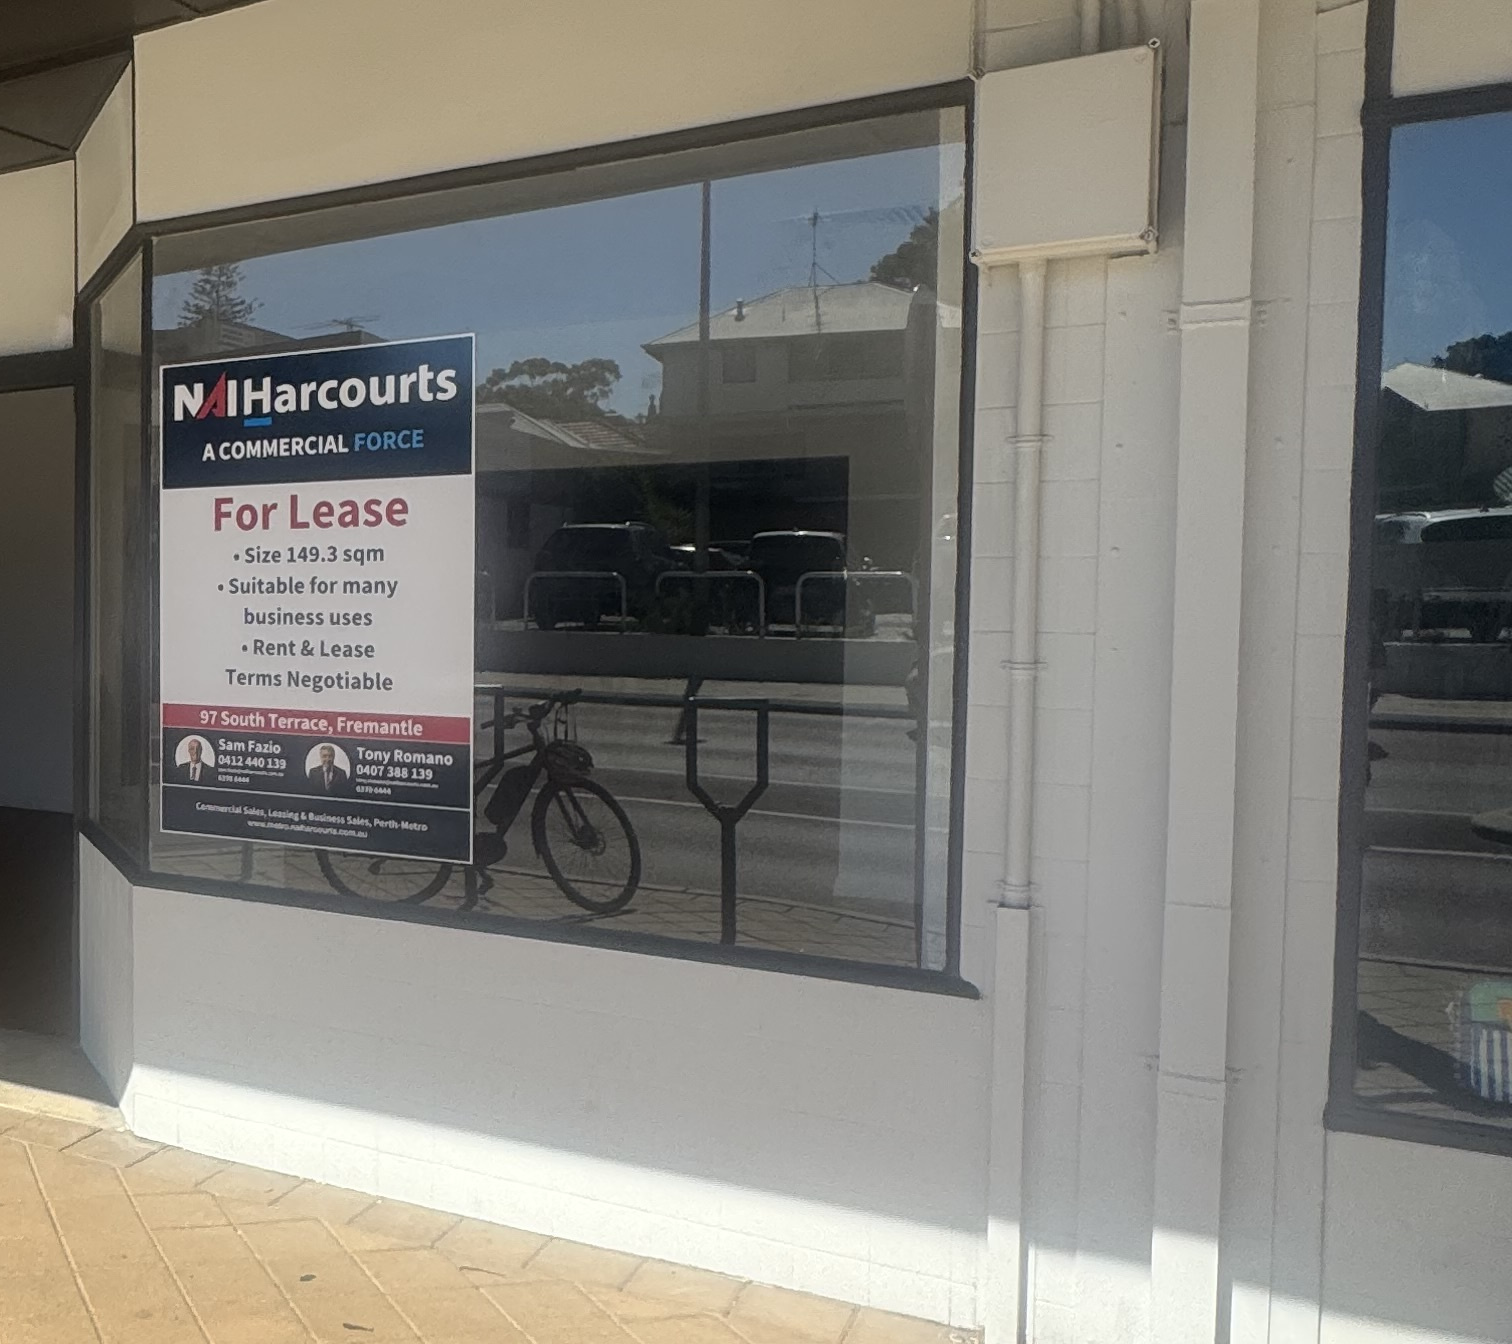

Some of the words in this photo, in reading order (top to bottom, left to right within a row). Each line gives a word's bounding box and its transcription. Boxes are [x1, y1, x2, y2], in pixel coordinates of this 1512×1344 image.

[243, 364, 457, 415] Harcourts
[202, 443, 216, 462] A
[219, 434, 349, 460] COMMERCIAL
[353, 429, 425, 452] FORCE
[213, 497, 278, 532] For
[289, 494, 409, 530] Lease
[244, 547, 282, 564] Size
[286, 546, 338, 564] 149.3
[342, 548, 385, 567] sqm
[228, 577, 305, 595] Suitable
[309, 576, 337, 594] for
[342, 579, 398, 598] many
[243, 607, 324, 626] business
[329, 612, 373, 626] uses
[253, 639, 296, 656] Rent
[300, 640, 315, 657] &
[320, 640, 375, 658] Lease
[225, 668, 282, 687] Terms
[287, 671, 394, 693] Negotiable
[199, 710, 217, 726] 97
[220, 711, 265, 728] South
[268, 713, 333, 735] Terrace,
[337, 716, 424, 737] Fremantle
[218, 738, 246, 753] Sam
[248, 740, 281, 754] Fazio
[356, 747, 390, 765] Tony
[393, 749, 454, 766] Romano
[218, 756, 243, 767] 0412
[245, 757, 265, 768] 440
[266, 758, 287, 770] 139
[356, 764, 384, 776] 0407
[387, 766, 408, 779] 388
[411, 767, 433, 780] 139
[195, 801, 242, 814] Commercial
[268, 809, 299, 821] Leasing
[300, 812, 308, 821] &
[308, 812, 345, 825] Business
